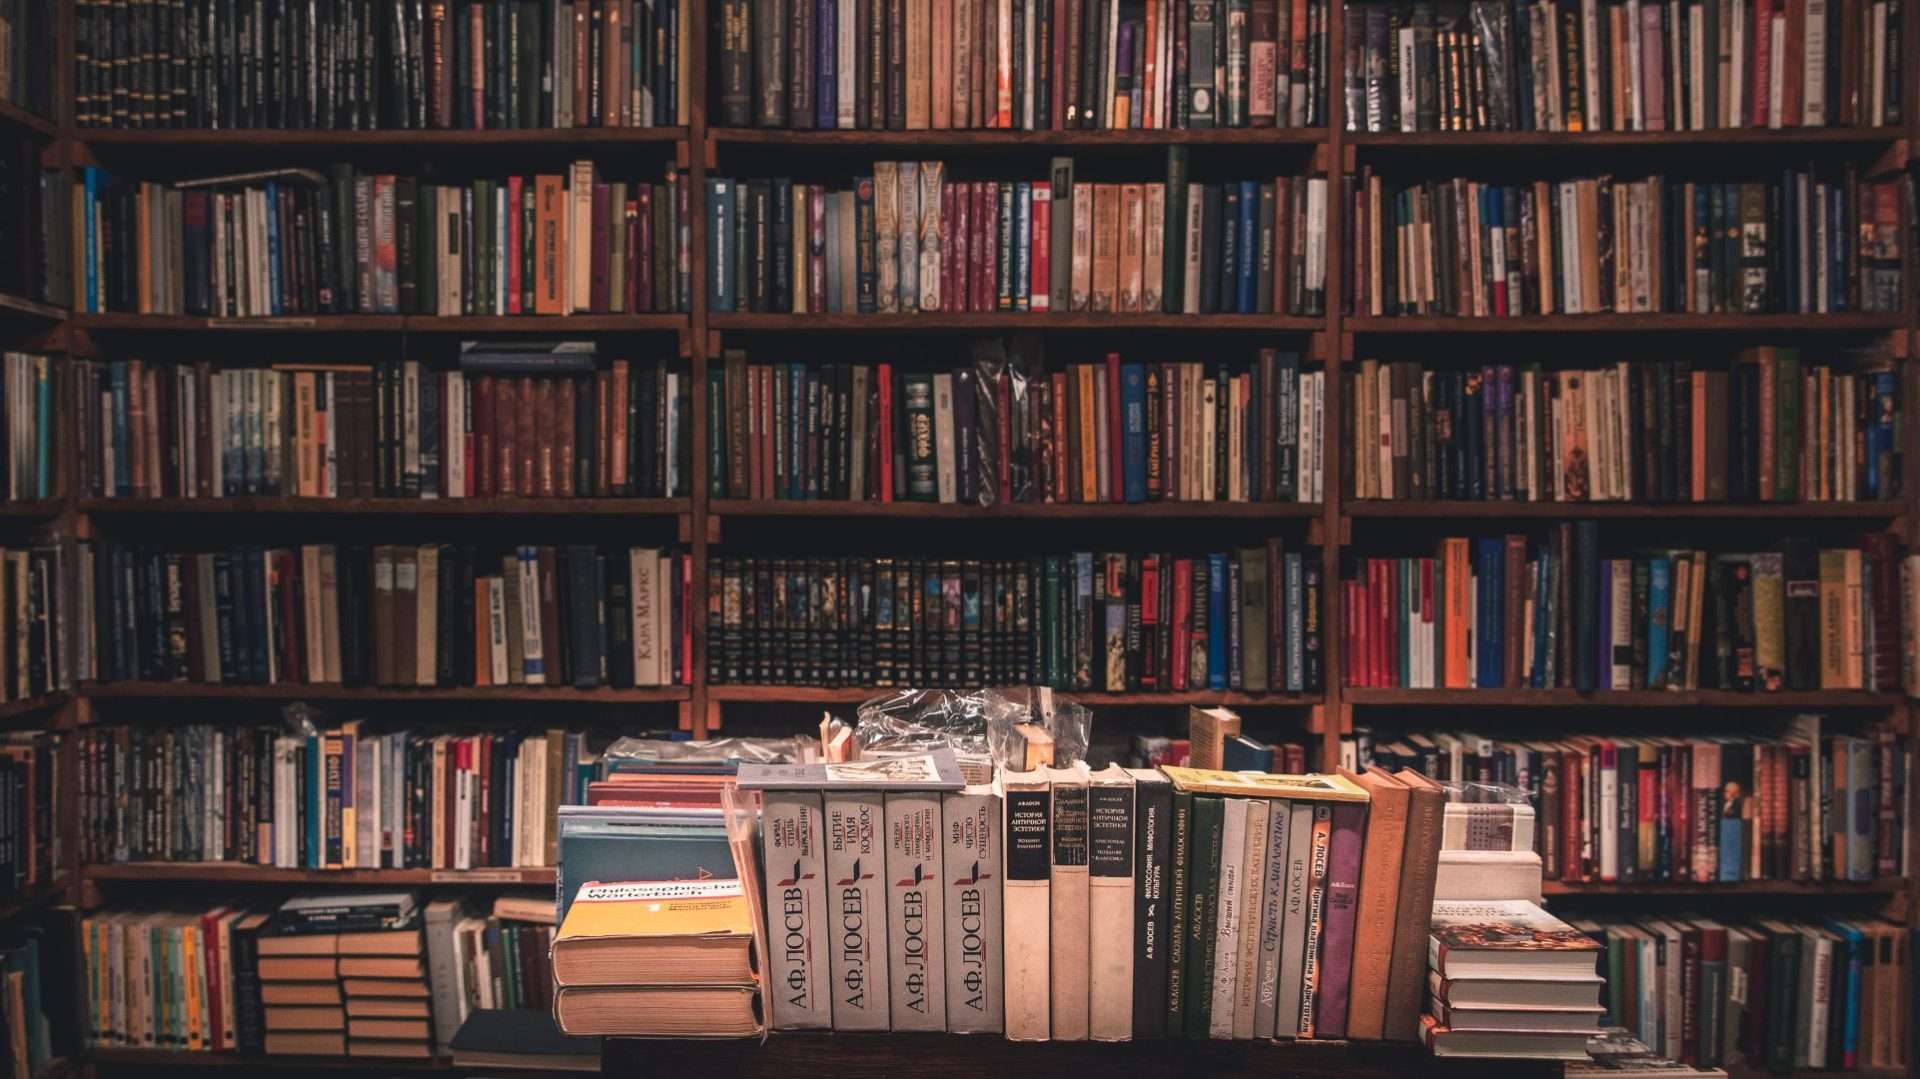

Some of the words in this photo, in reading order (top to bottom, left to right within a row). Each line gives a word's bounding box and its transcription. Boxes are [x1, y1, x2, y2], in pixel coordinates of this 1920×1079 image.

[774, 818, 782, 849] ФОРМА
[786, 818, 795, 847] СТИЛЬ
[799, 806, 808, 856] ВЫРАЖЕНИЕ
[832, 811, 843, 852] БЫТИЕ
[846, 817, 856, 844] ИМЯ
[859, 805, 870, 855] КОСМОС
[952, 821, 960, 844] МИФ
[965, 817, 974, 849] ЧИСЛО
[978, 806, 987, 860] СУЩНОСТЬ
[1176, 808, 1187, 867] ФИЛОСОФИИ
[1269, 811, 1284, 888] диалектике
[1153, 865, 1161, 900] КУЛЬТУРА
[1314, 844, 1325, 878] ЛОСЕВ
[588, 884, 740, 894] Philosophische
[1174, 869, 1184, 920] АНТИЧНОЙ
[1311, 887, 1322, 923] Критика
[1146, 921, 1154, 959] А.Ф.ЛОСЕВ
[1173, 922, 1182, 963] СЛОВАРЬ
[1245, 878, 1259, 959] ЭСТЕТИЧЕСКИХ
[1262, 899, 1279, 952] Страсть
[783, 887, 806, 1010] А.Ф.ЛОСЕВ
[842, 887, 864, 1010] А.Ф.ЛОСЕВ
[904, 890, 926, 1014] А.Ф.ЛОСЕВ
[961, 888, 984, 1012] А.Ф.ЛОСЕВ
[1306, 925, 1319, 975] платонизма
[1242, 960, 1253, 1008] ИСТОРИЯ
[1302, 983, 1314, 1034] Аристотеля
